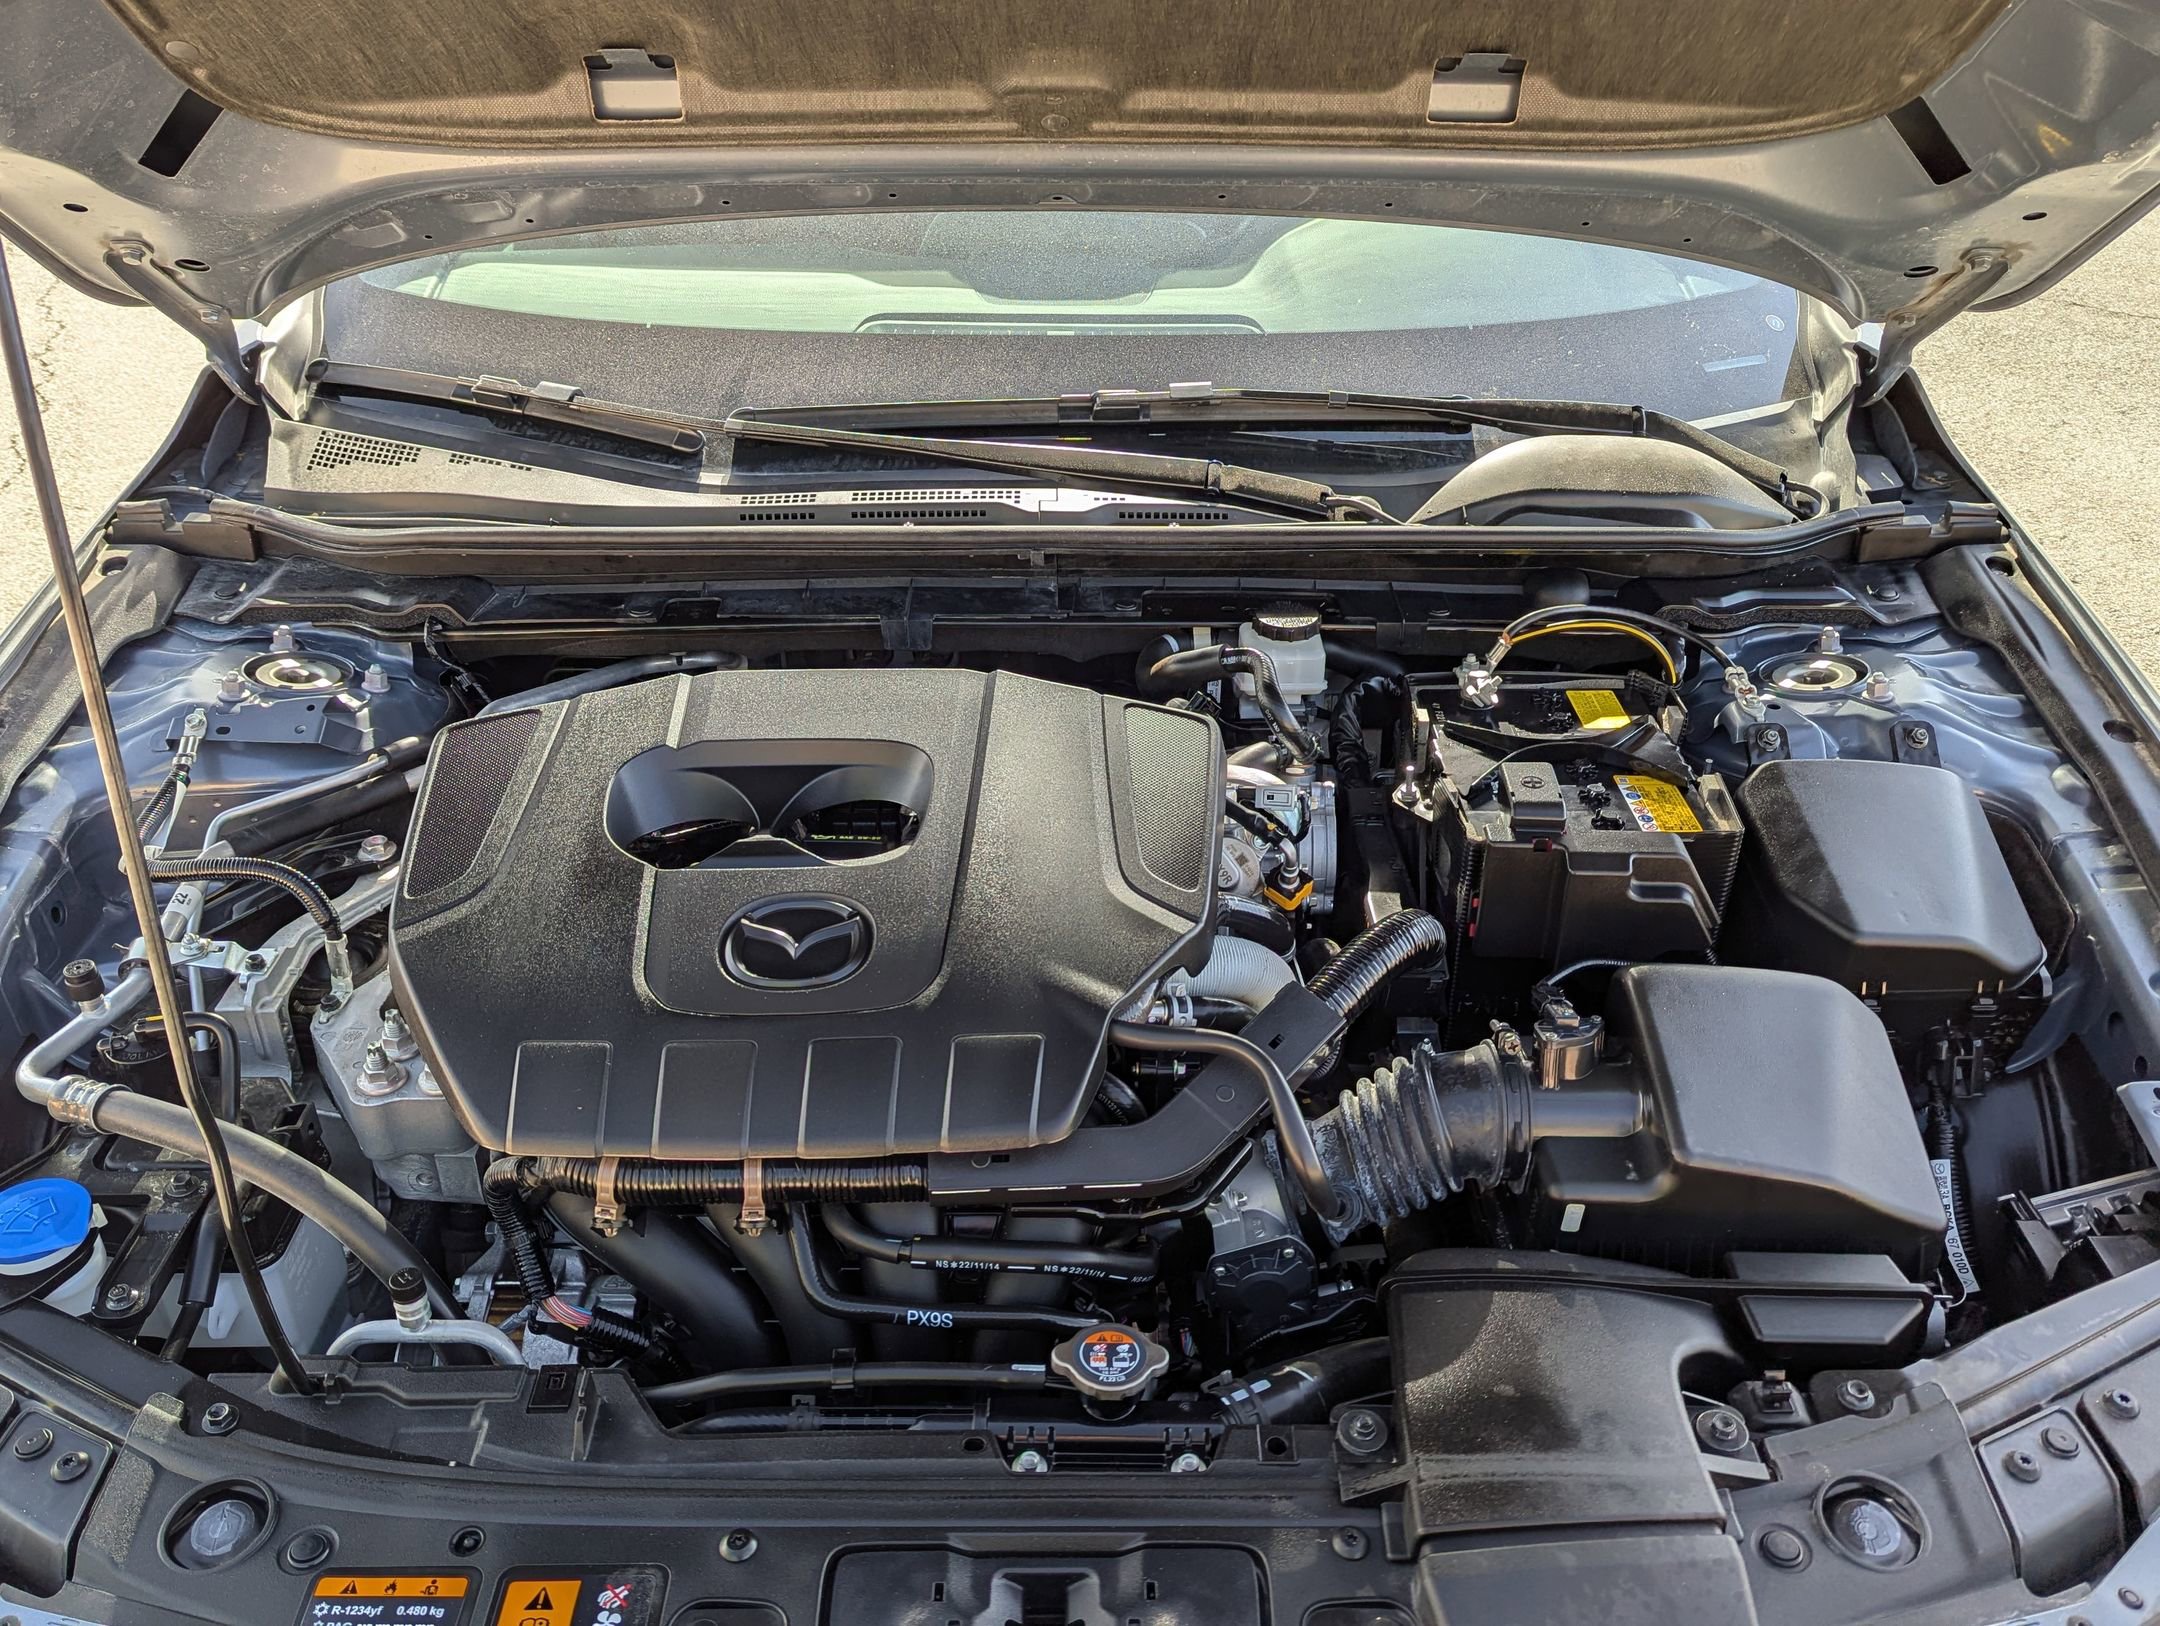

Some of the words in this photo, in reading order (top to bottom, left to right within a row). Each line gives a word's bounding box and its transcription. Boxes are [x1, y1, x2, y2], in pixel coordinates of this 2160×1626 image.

[171, 892, 189, 905] 22
[1947, 1237, 1960, 1249] 67
[1952, 1252, 1970, 1275] 010D
[907, 1309, 953, 1328] PX9S
[331, 1605, 384, 1618] R-1234yf
[396, 1605, 428, 1616] 0.480
[429, 1606, 445, 1618] kg
